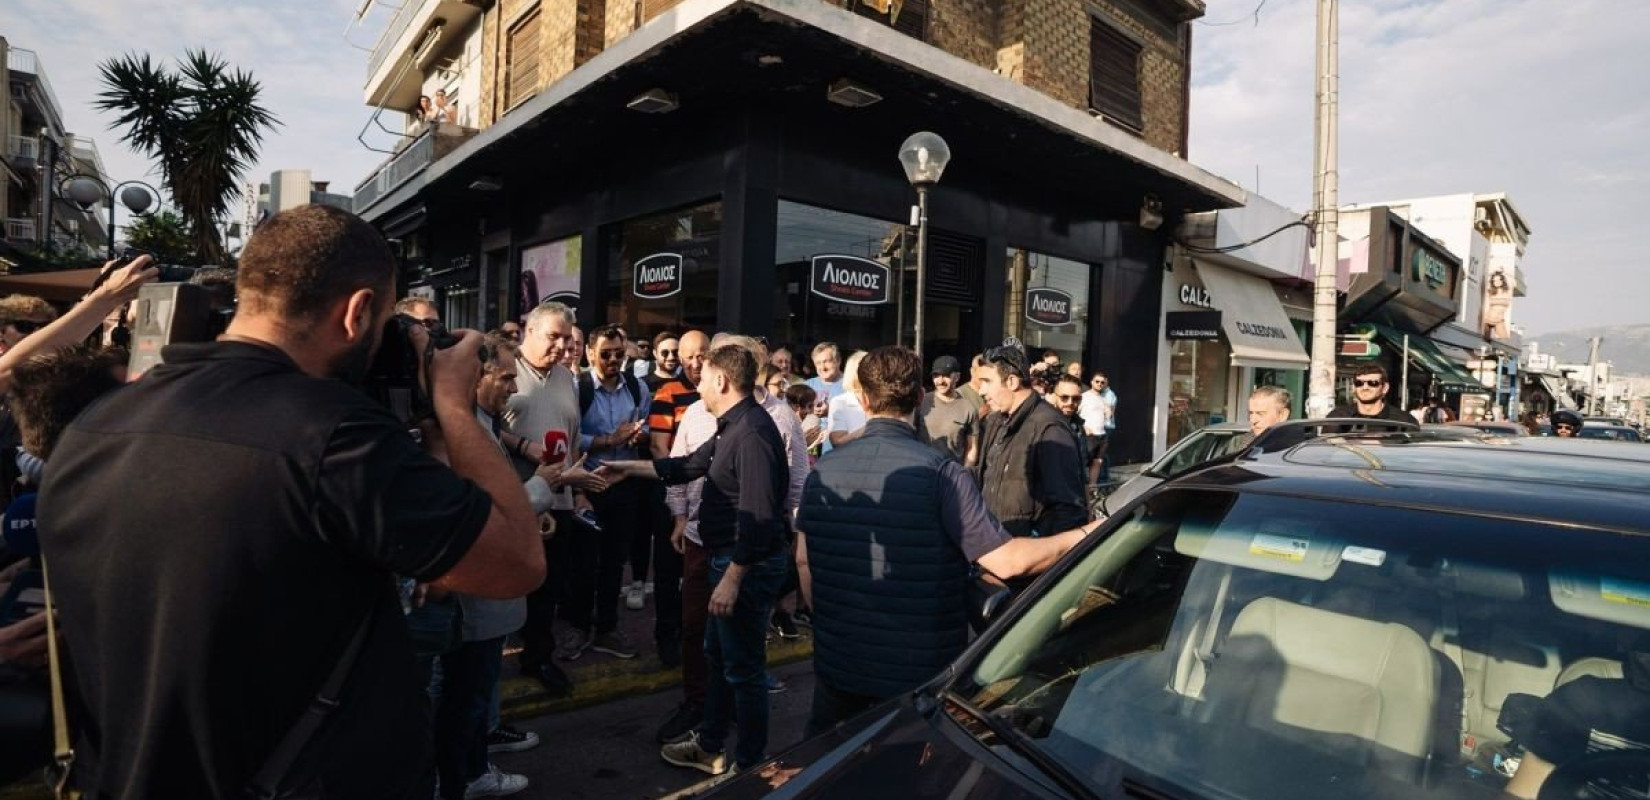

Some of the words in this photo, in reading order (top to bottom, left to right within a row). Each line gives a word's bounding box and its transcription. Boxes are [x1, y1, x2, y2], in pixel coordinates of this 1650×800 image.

[639, 265, 675, 284] ΛΙΟΛΙΟΣ
[823, 261, 879, 289] ΛΙΟΛΙΟΣ
[1170, 329, 1218, 337] CALZEDONIA
[1236, 321, 1287, 340] CALZEDONIA
